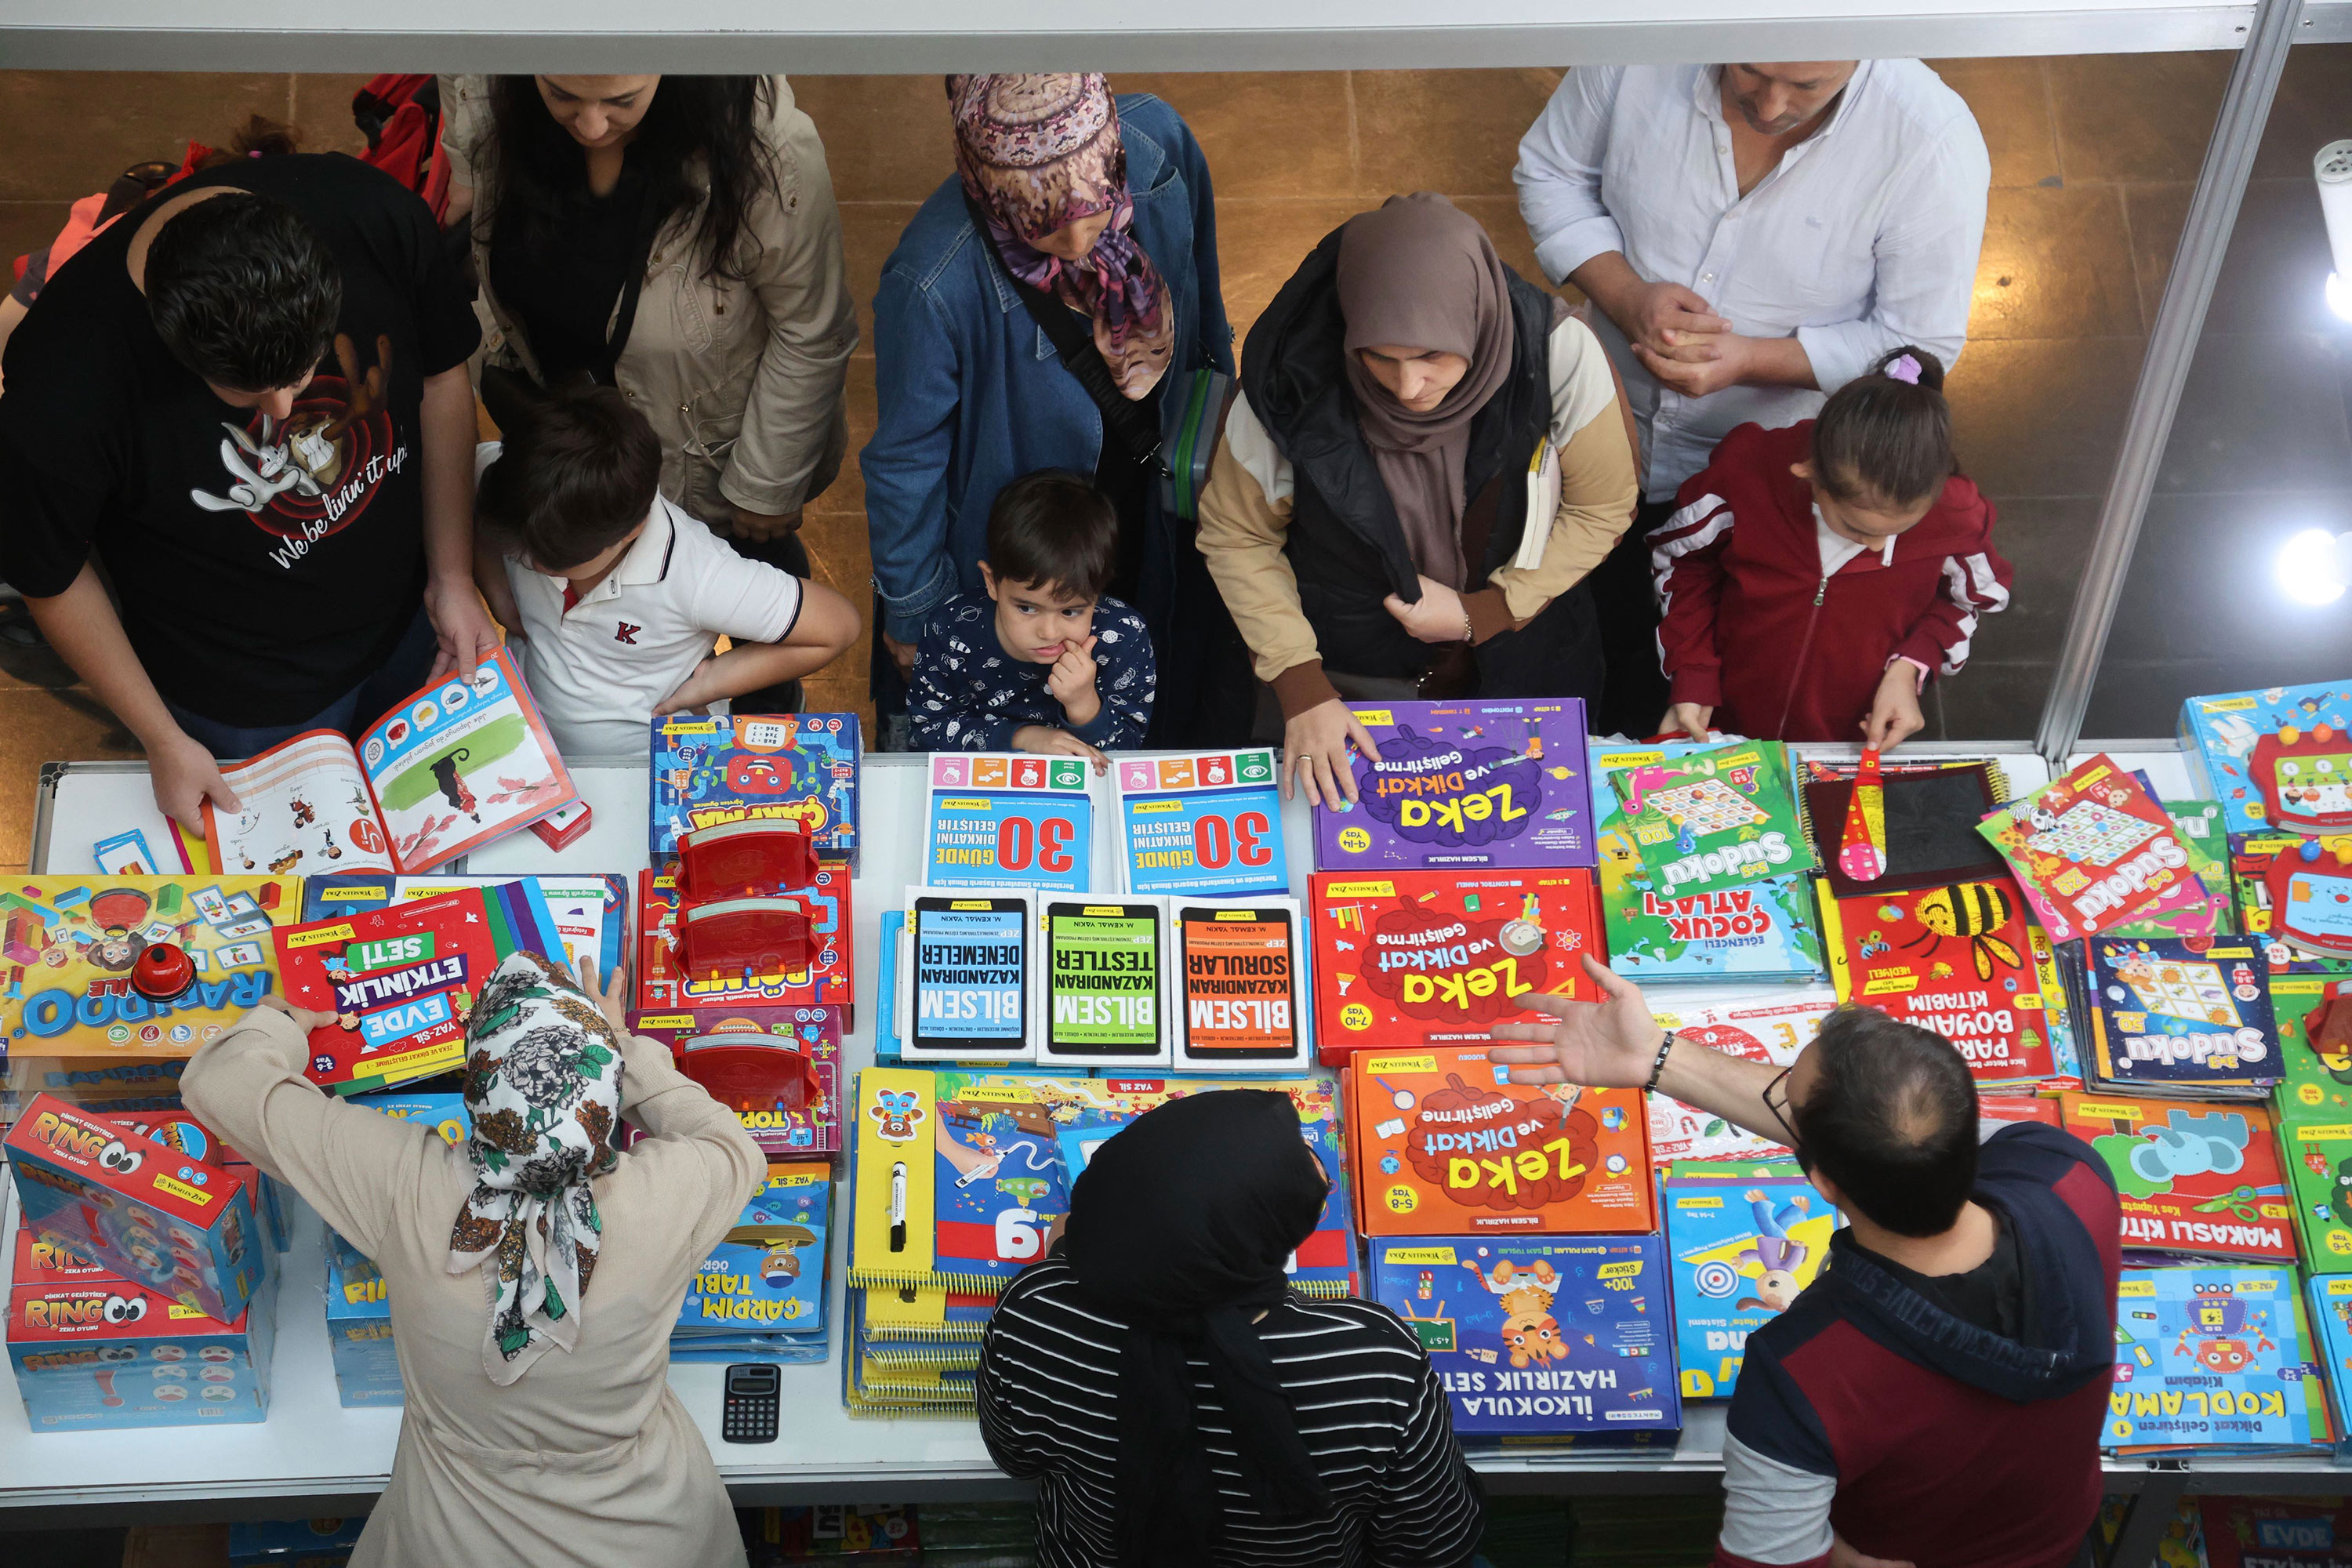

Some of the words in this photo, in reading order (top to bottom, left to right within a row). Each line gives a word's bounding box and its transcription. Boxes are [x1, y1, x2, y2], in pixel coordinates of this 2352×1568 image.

[269, 535, 308, 569] We
[301, 520, 328, 543] be
[322, 473, 364, 521] livin'
[366, 455, 384, 484] it
[615, 621, 641, 644] K
[473, 713, 487, 724] Jale
[1374, 751, 1462, 773] Geliştirme
[1465, 766, 1490, 780] ve
[1377, 771, 1465, 798] Dikkat
[1401, 784, 1527, 833] Zeka
[938, 818, 996, 833] GELİŞTİR
[1132, 821, 1190, 837] GELİŞTİR
[1345, 830, 1362, 839] Yaş
[936, 833, 995, 846] DİKKATİNİ
[997, 816, 1074, 873] 30
[1133, 835, 1192, 850] DİKKATİNİ
[1193, 811, 1272, 869] 30
[1343, 839, 1367, 849] 9-14
[1638, 827, 1674, 845] 100
[936, 848, 994, 867] GÜNDE
[1135, 850, 1194, 869] GÜNDE
[1661, 832, 1791, 886] Sudoku
[2058, 873, 2091, 896] 120
[2071, 837, 2187, 920] Sudoku
[1643, 890, 1753, 917] ATLASI
[1668, 905, 1771, 940] ÇOCUK
[290, 935, 306, 944] ZEKA
[307, 931, 338, 941] YÜKSELEN
[1376, 923, 1466, 946] Geliştirme
[1704, 936, 1764, 948] EĞLENCELİ
[361, 938, 423, 969] SETİ
[1468, 938, 1494, 953] ve
[922, 945, 1019, 965] DENEMELER
[1056, 950, 1153, 971] TESTLER
[1378, 944, 1470, 973] Dikkat
[1189, 955, 1287, 975] SORULAR
[1868, 966, 1911, 979] HEDİYELİ
[338, 956, 463, 1007] ETKİNLİK
[921, 969, 1019, 984] KAZANDIRAN
[1055, 975, 1152, 989] KAZANDIRAN
[1403, 957, 1533, 1010] Zeka
[1190, 979, 1287, 994] KAZANDIRAN
[920, 989, 1019, 1024] BİLSEM
[1907, 990, 1988, 1011] KİTABIM
[367, 998, 444, 1037] EVDE
[1055, 995, 1153, 1029] BİLSEM
[1190, 1000, 1290, 1034] BİLSEM
[1345, 1017, 1367, 1025] 7-10
[412, 1022, 456, 1041] YAZ-SİL
[2118, 1018, 2145, 1033] 50
[2125, 1027, 2267, 1065] Sudoku
[316, 1056, 332, 1065] Yaş
[376, 1054, 408, 1067] GELİŞTİRME
[409, 1050, 429, 1061] DİKKAT
[2009, 1058, 2026, 1068] İnce
[2208, 1055, 2239, 1069] 3x3
[318, 1062, 332, 1071] 3-6
[961, 1090, 979, 1098] ZEKA
[982, 1090, 1014, 1098] YÜKSELEN
[1119, 1083, 1135, 1092] SİL
[1422, 1098, 1514, 1126] Geliştirme
[60, 1112, 84, 1127] DİKKAT
[83, 1121, 116, 1139] GELİŞTİREN
[1517, 1118, 1544, 1135] ve
[1425, 1125, 1518, 1156] Dikkat
[53, 1149, 68, 1160] ZEKA
[68, 1153, 89, 1167] OYUNU
[1449, 1138, 1586, 1195] Zeka
[776, 1178, 787, 1186] SİL
[167, 1181, 191, 1198] YÜKSELEN
[191, 1192, 205, 1203] ZEKA
[1392, 1189, 1410, 1197] Yaş
[1392, 1199, 1413, 1208] 5-8
[2162, 1206, 2180, 1216] Kes
[2171, 1221, 2282, 1249] MAKASLI
[1605, 1265, 1635, 1274] Sticker
[1604, 1278, 1635, 1290] 100+
[701, 1297, 800, 1319] ÇARPIM
[1689, 1319, 1726, 1327] Sistemi
[1494, 1370, 1617, 1391] HAZIRLIK
[2165, 1376, 2223, 1388] Kitabım
[1461, 1396, 1592, 1421] İLKOKULA
[2110, 1391, 2285, 1417] KODLAMA
[2139, 1420, 2209, 1433] Geliştiren
[2214, 1421, 2262, 1432] Dikkat
